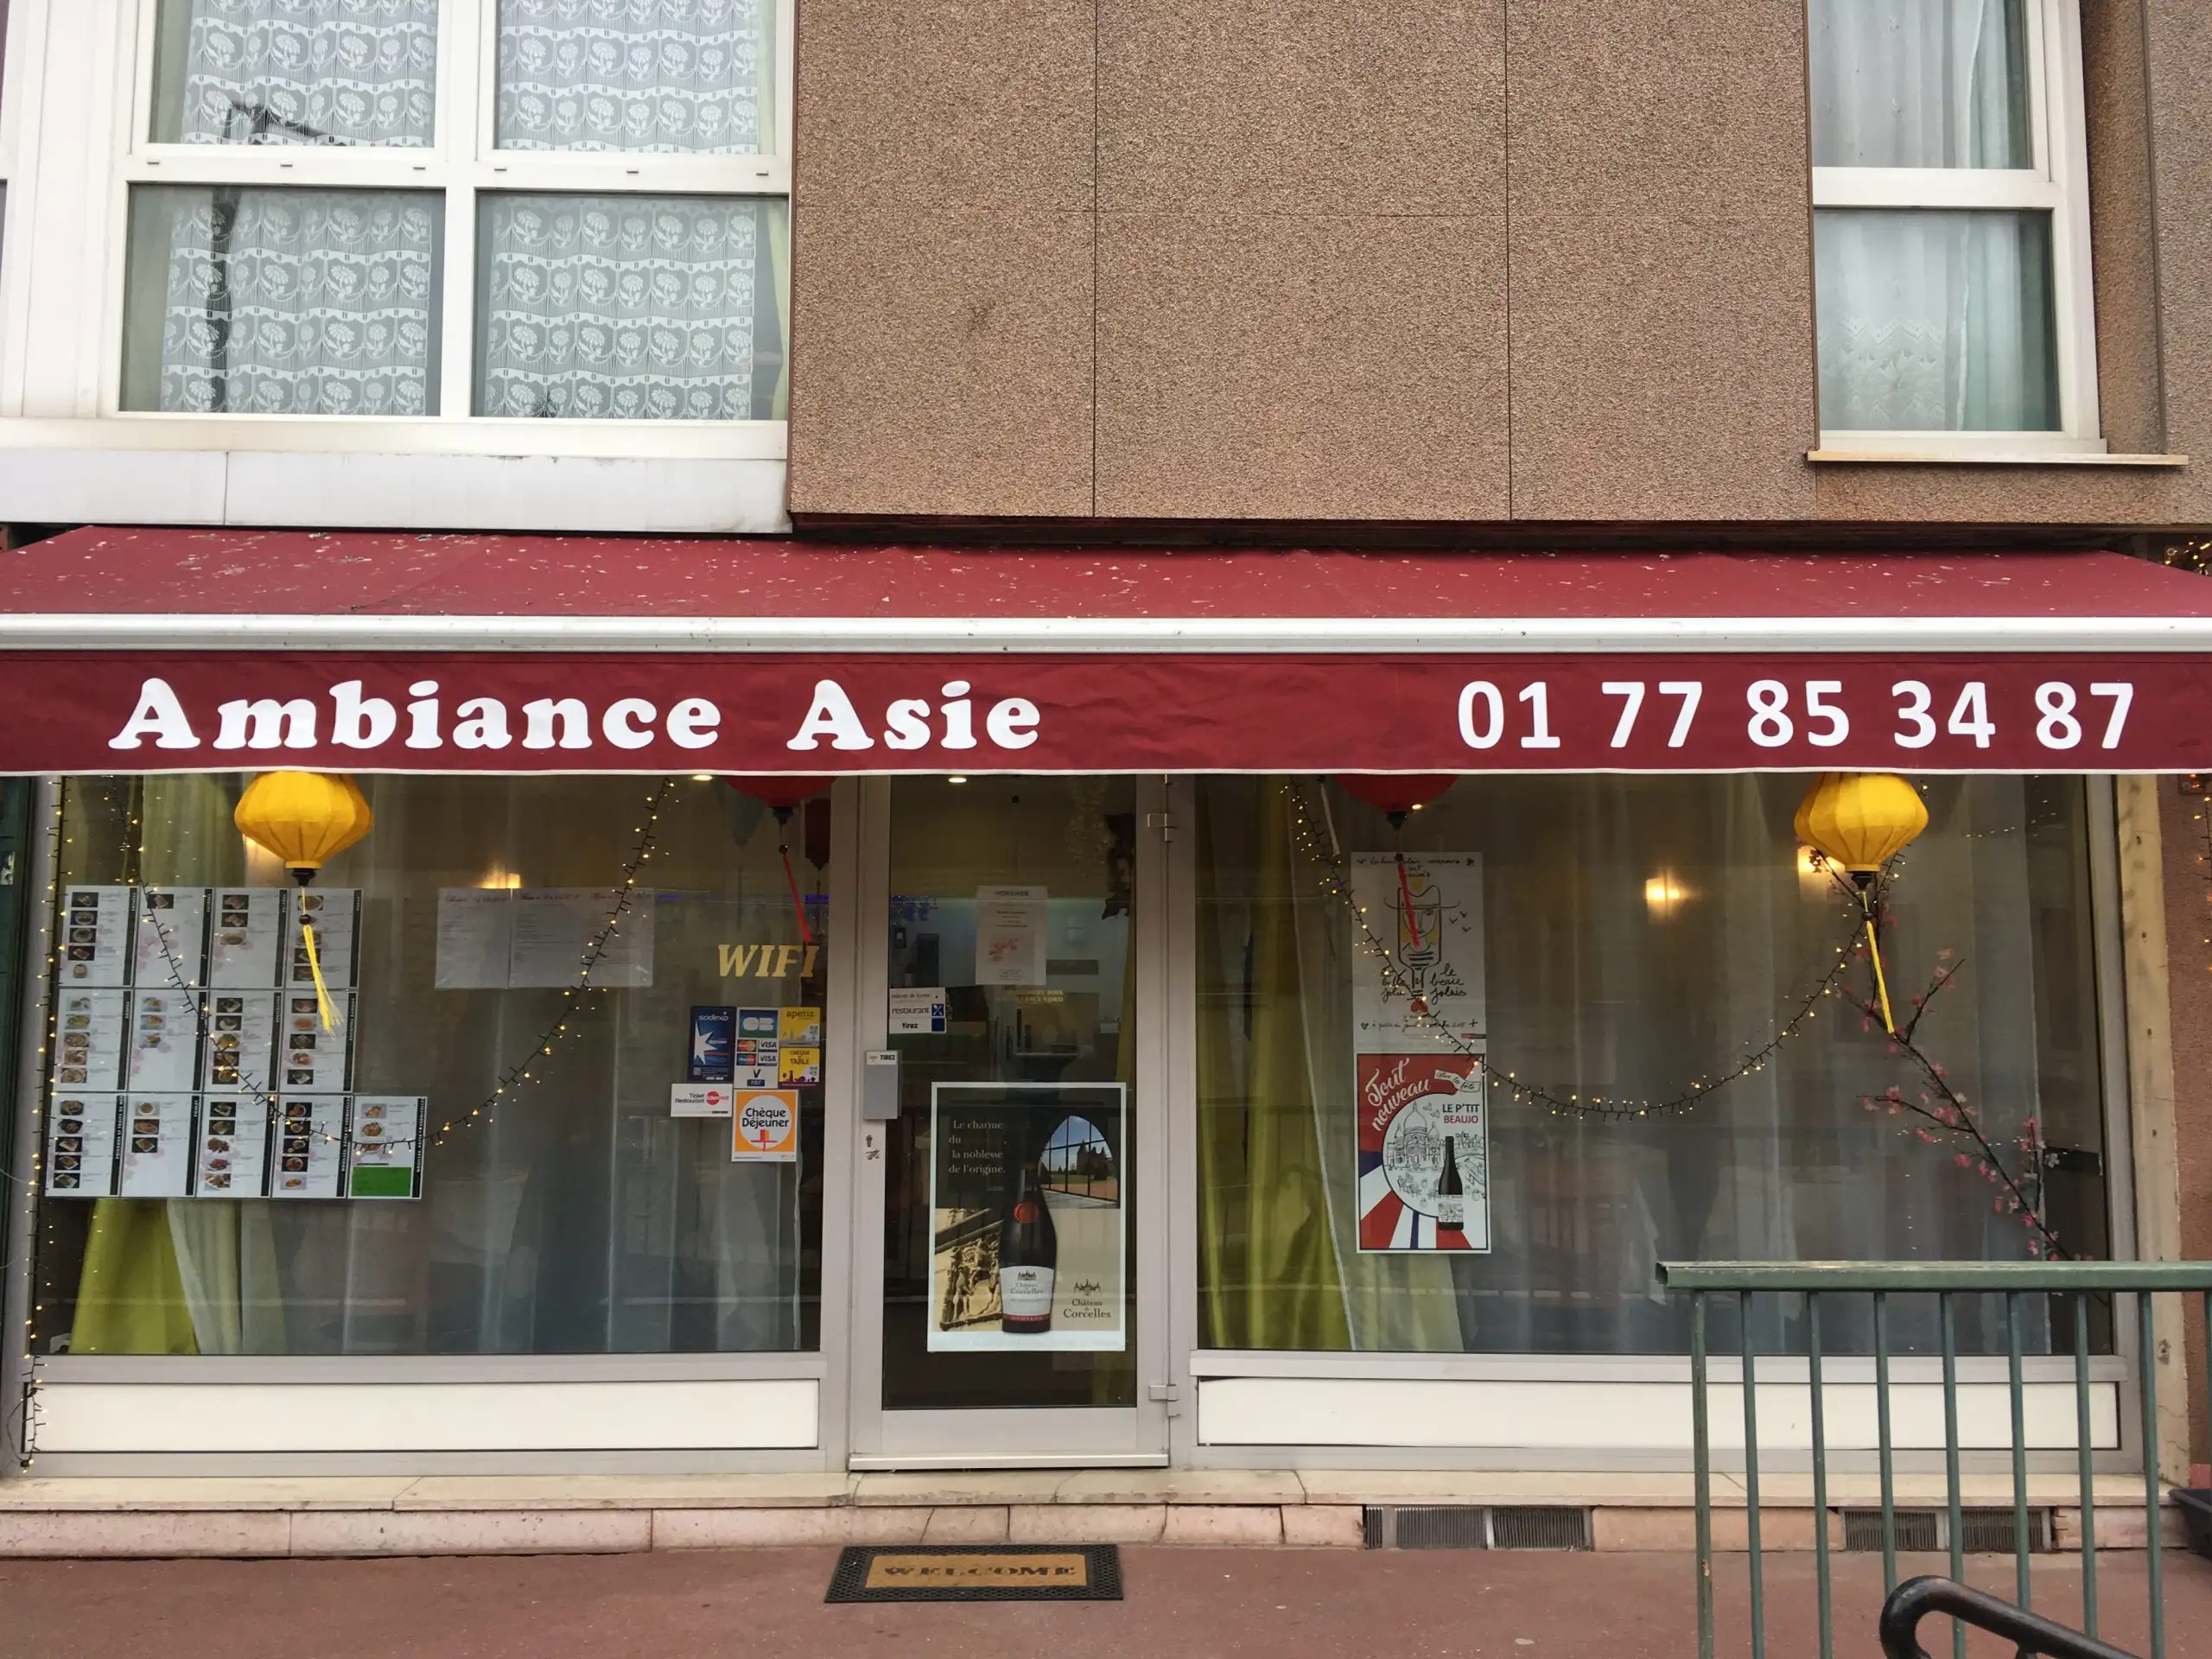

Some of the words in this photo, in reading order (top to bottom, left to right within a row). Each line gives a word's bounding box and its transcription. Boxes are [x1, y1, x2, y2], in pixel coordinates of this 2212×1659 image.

[108, 677, 722, 752] Ambiance
[785, 678, 1041, 752] Asie
[1457, 679, 1561, 750] 01
[1600, 680, 1704, 750] 77
[1745, 679, 1851, 749] 85
[1892, 681, 1997, 750] 34
[2035, 682, 2136, 750] 87
[718, 944, 820, 978] WIFI
[698, 1011, 729, 1021] sodexo
[785, 1009, 815, 1019] apetiz
[1364, 1057, 1410, 1107] Tout
[1371, 1077, 1432, 1132] nouveau
[1442, 1103, 1452, 1113] LE
[1455, 1103, 1480, 1113] P'TIT
[746, 1107, 786, 1119] Chèque
[742, 1117, 789, 1129] Déjeuner
[953, 1120, 965, 1129] Le
[967, 1120, 1003, 1129] charme
[1443, 1116, 1479, 1124] BEAUJO
[949, 1135, 962, 1144] du
[952, 1149, 960, 1159] la
[963, 1149, 1003, 1159] noblesse
[948, 1164, 961, 1173] de
[963, 1164, 1006, 1176] l'origine.
[1071, 1298, 1103, 1306] Château
[1064, 1307, 1111, 1318] Corcelles
[884, 1566, 1076, 1577] WELCOME
